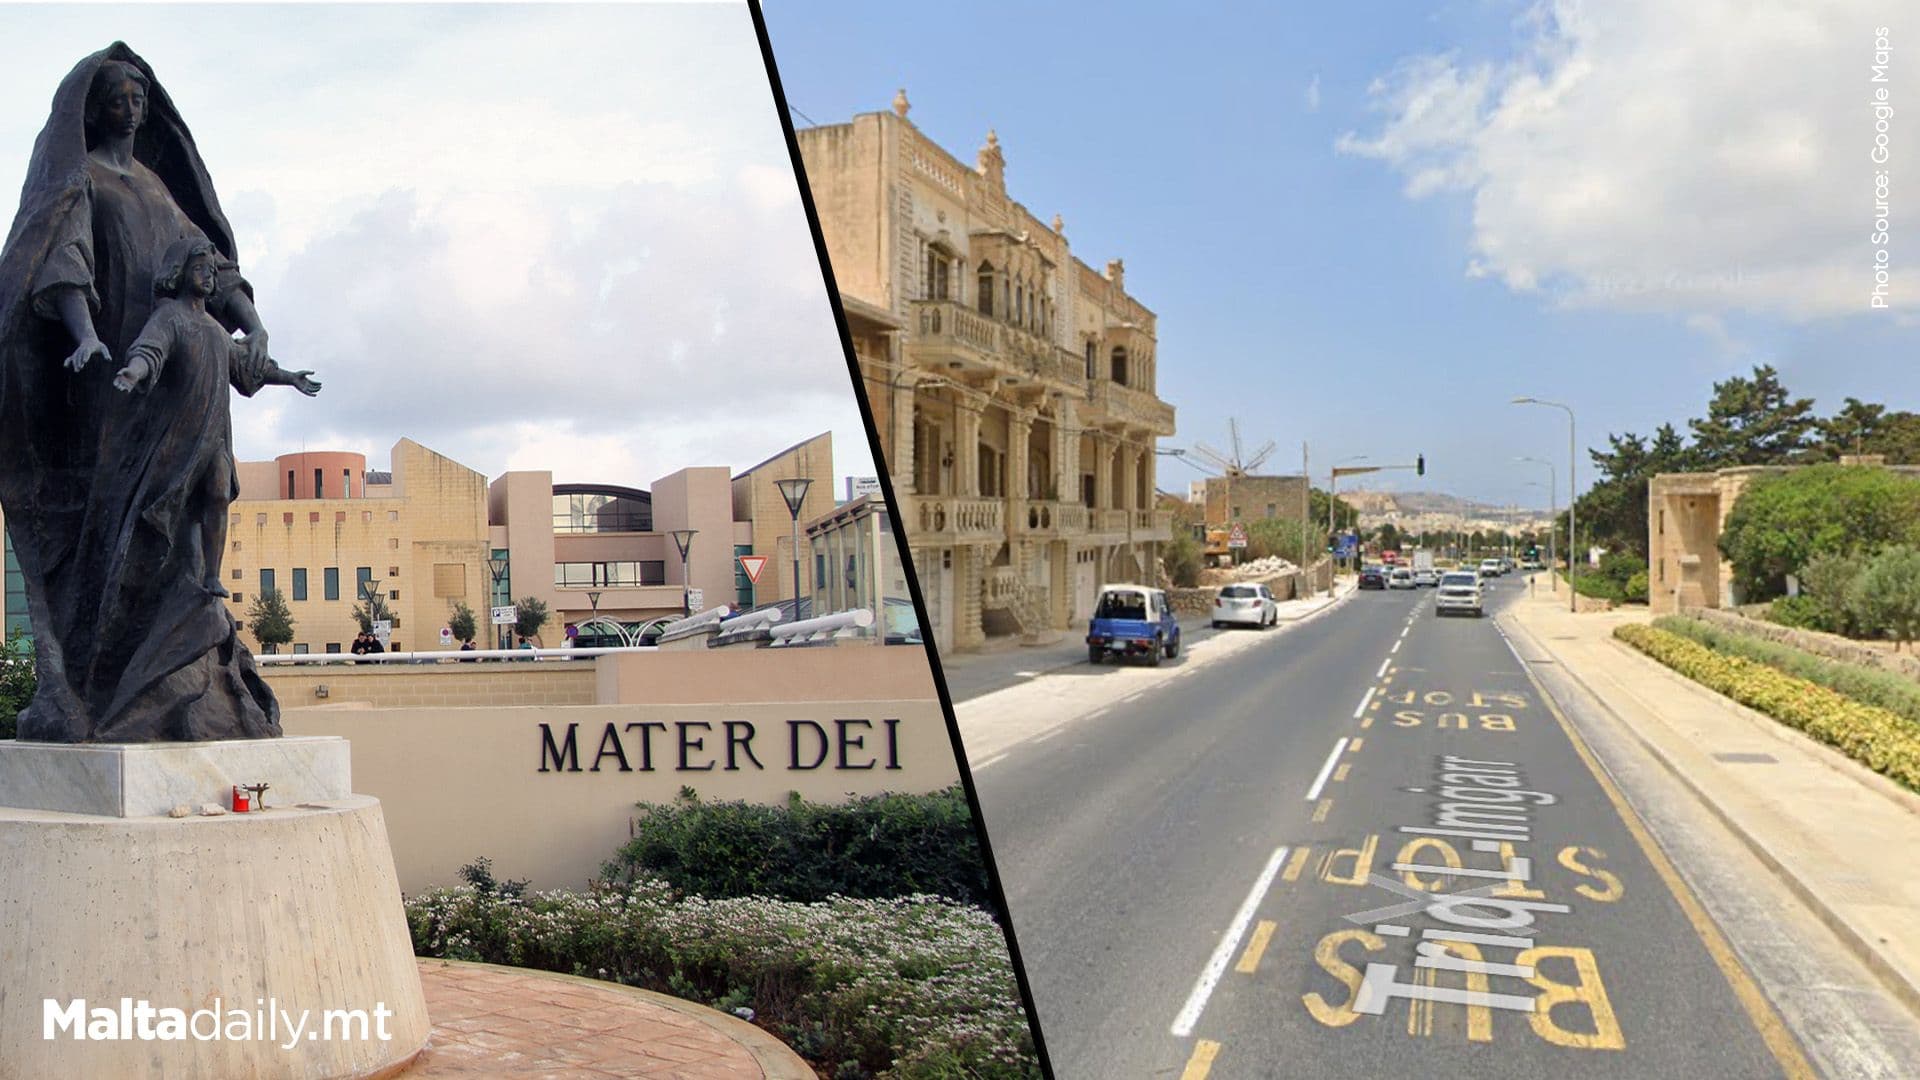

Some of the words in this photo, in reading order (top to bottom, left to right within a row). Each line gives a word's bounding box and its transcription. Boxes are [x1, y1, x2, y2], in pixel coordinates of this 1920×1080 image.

[537, 721, 764, 773] MATER
[786, 718, 903, 770] DEI
[1393, 710, 1517, 731] BUS
[1315, 834, 1625, 902] STOP
[1301, 929, 1626, 1050] BUS
